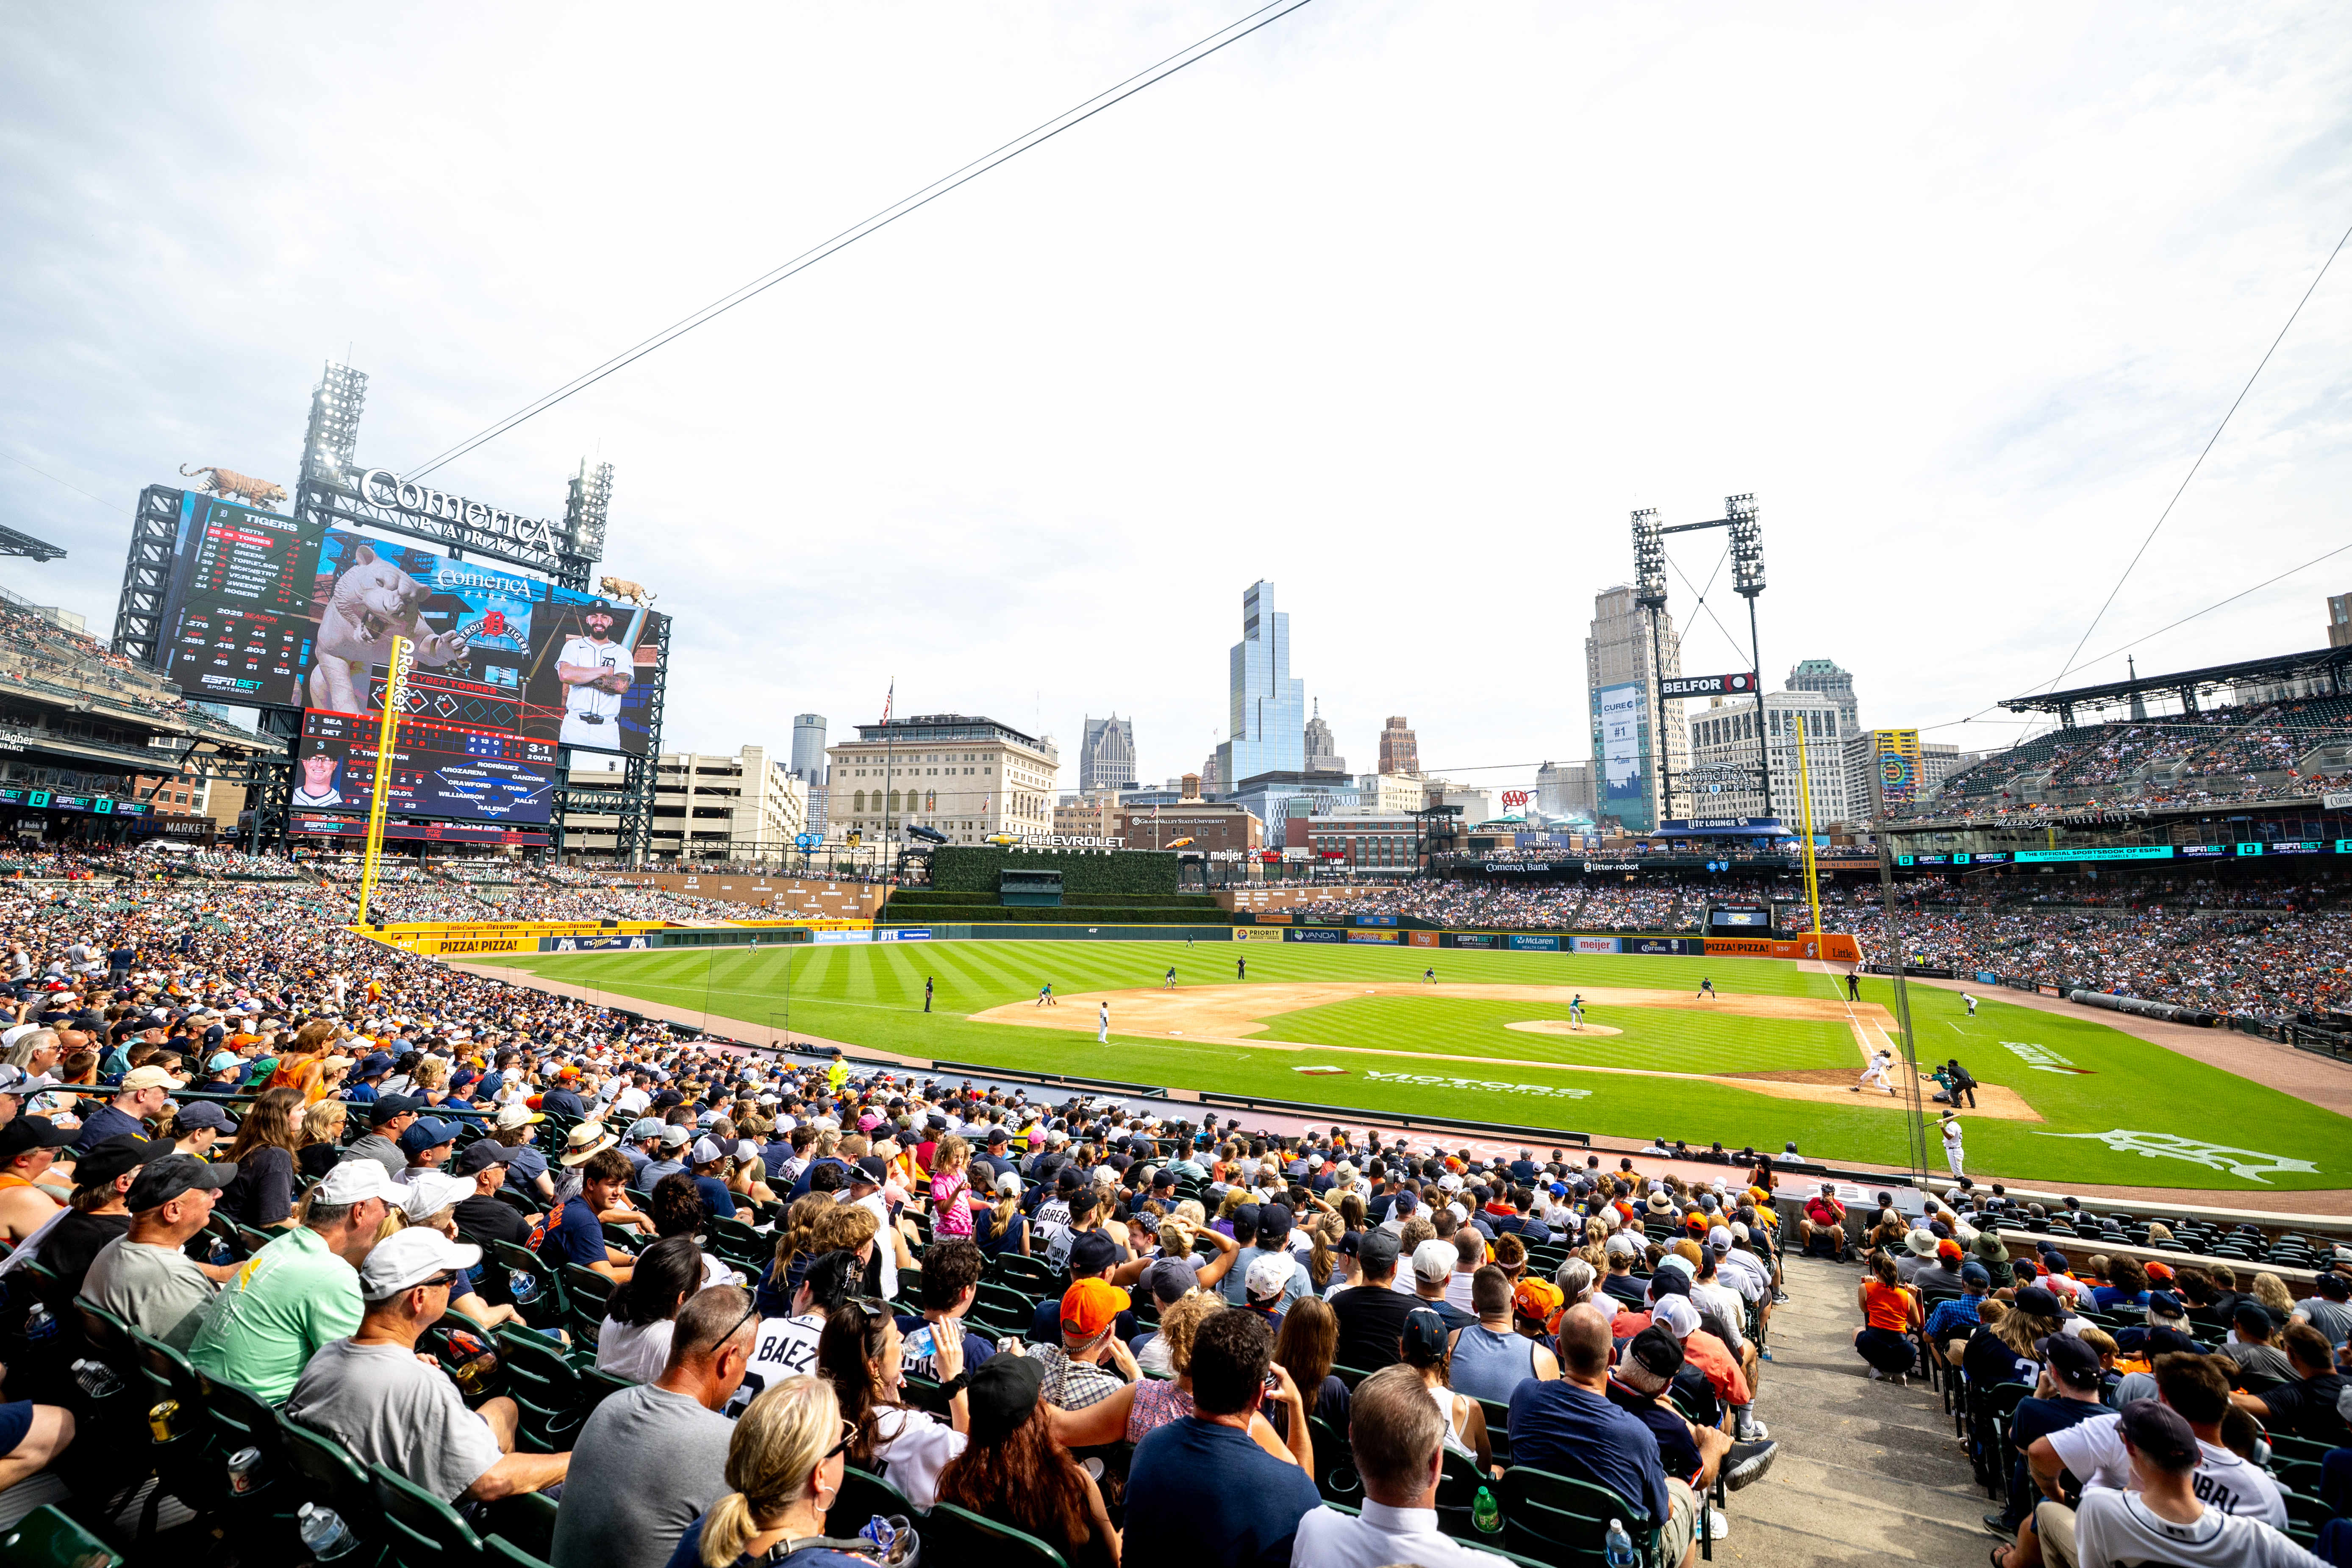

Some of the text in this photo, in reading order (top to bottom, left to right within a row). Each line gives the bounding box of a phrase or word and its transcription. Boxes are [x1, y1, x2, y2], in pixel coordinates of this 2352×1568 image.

[244, 513, 298, 532] TIGERS
[239, 527, 264, 536] KEITH
[418, 515, 509, 553] PARK
[239, 534, 271, 545] TORRES
[236, 542, 262, 551] PÉREZ
[234, 549, 266, 560] GREENE
[233, 557, 279, 570] TORKELSON
[229, 572, 266, 583] VIERLING
[227, 580, 267, 591] SWEENEY
[225, 588, 259, 598] ROGERS
[465, 590, 507, 602] PARK
[217, 608, 278, 623] 2025 SEASON
[186, 620, 208, 628] .276
[506, 625, 529, 655] TIGERS
[244, 647, 266, 655] .803
[201, 674, 263, 690] ESPN BET
[392, 653, 414, 713] Rocket
[450, 681, 497, 694] TORRES
[1663, 679, 1721, 693] BELFOR
[207, 685, 254, 694] SPORTSBOOK
[1604, 703, 1626, 711] CURE
[323, 718, 342, 726] SEA
[1614, 727, 1626, 737] #1
[528, 743, 549, 754] 3-1
[1786, 730, 1800, 775] Rocket
[441, 767, 487, 776] AROZARENA
[478, 762, 519, 771] RODRÍGUEZ
[448, 780, 491, 789] CRAWFORD
[1681, 784, 1750, 793] LANDING
[56, 796, 89, 806] ESPN BET
[439, 791, 485, 800] WILLIAMSON
[1505, 791, 1527, 802] AAA
[1688, 819, 1704, 829] Lite
[2063, 813, 2130, 825] TIGER CLUB
[25, 821, 40, 829] Modelo
[166, 822, 208, 833] MARKET
[1027, 834, 1126, 847] CHEVROLET
[1536, 831, 1550, 842] Lite
[1210, 849, 1243, 863] meijer
[881, 931, 898, 940] DTE
[1352, 932, 1378, 940] Surfside
[1417, 934, 1430, 945] hap
[440, 940, 517, 952] PIZZA! PIZZA!
[592, 937, 614, 949] Miller
[1580, 939, 1610, 951] meijer
[1641, 944, 1666, 952] Corona
[1705, 943, 1769, 952] PIZZA! PIZZA!
[1833, 948, 1853, 958] Little
[1366, 1070, 1593, 1096] VICTORS
[758, 1336, 819, 1373] BAEZ
